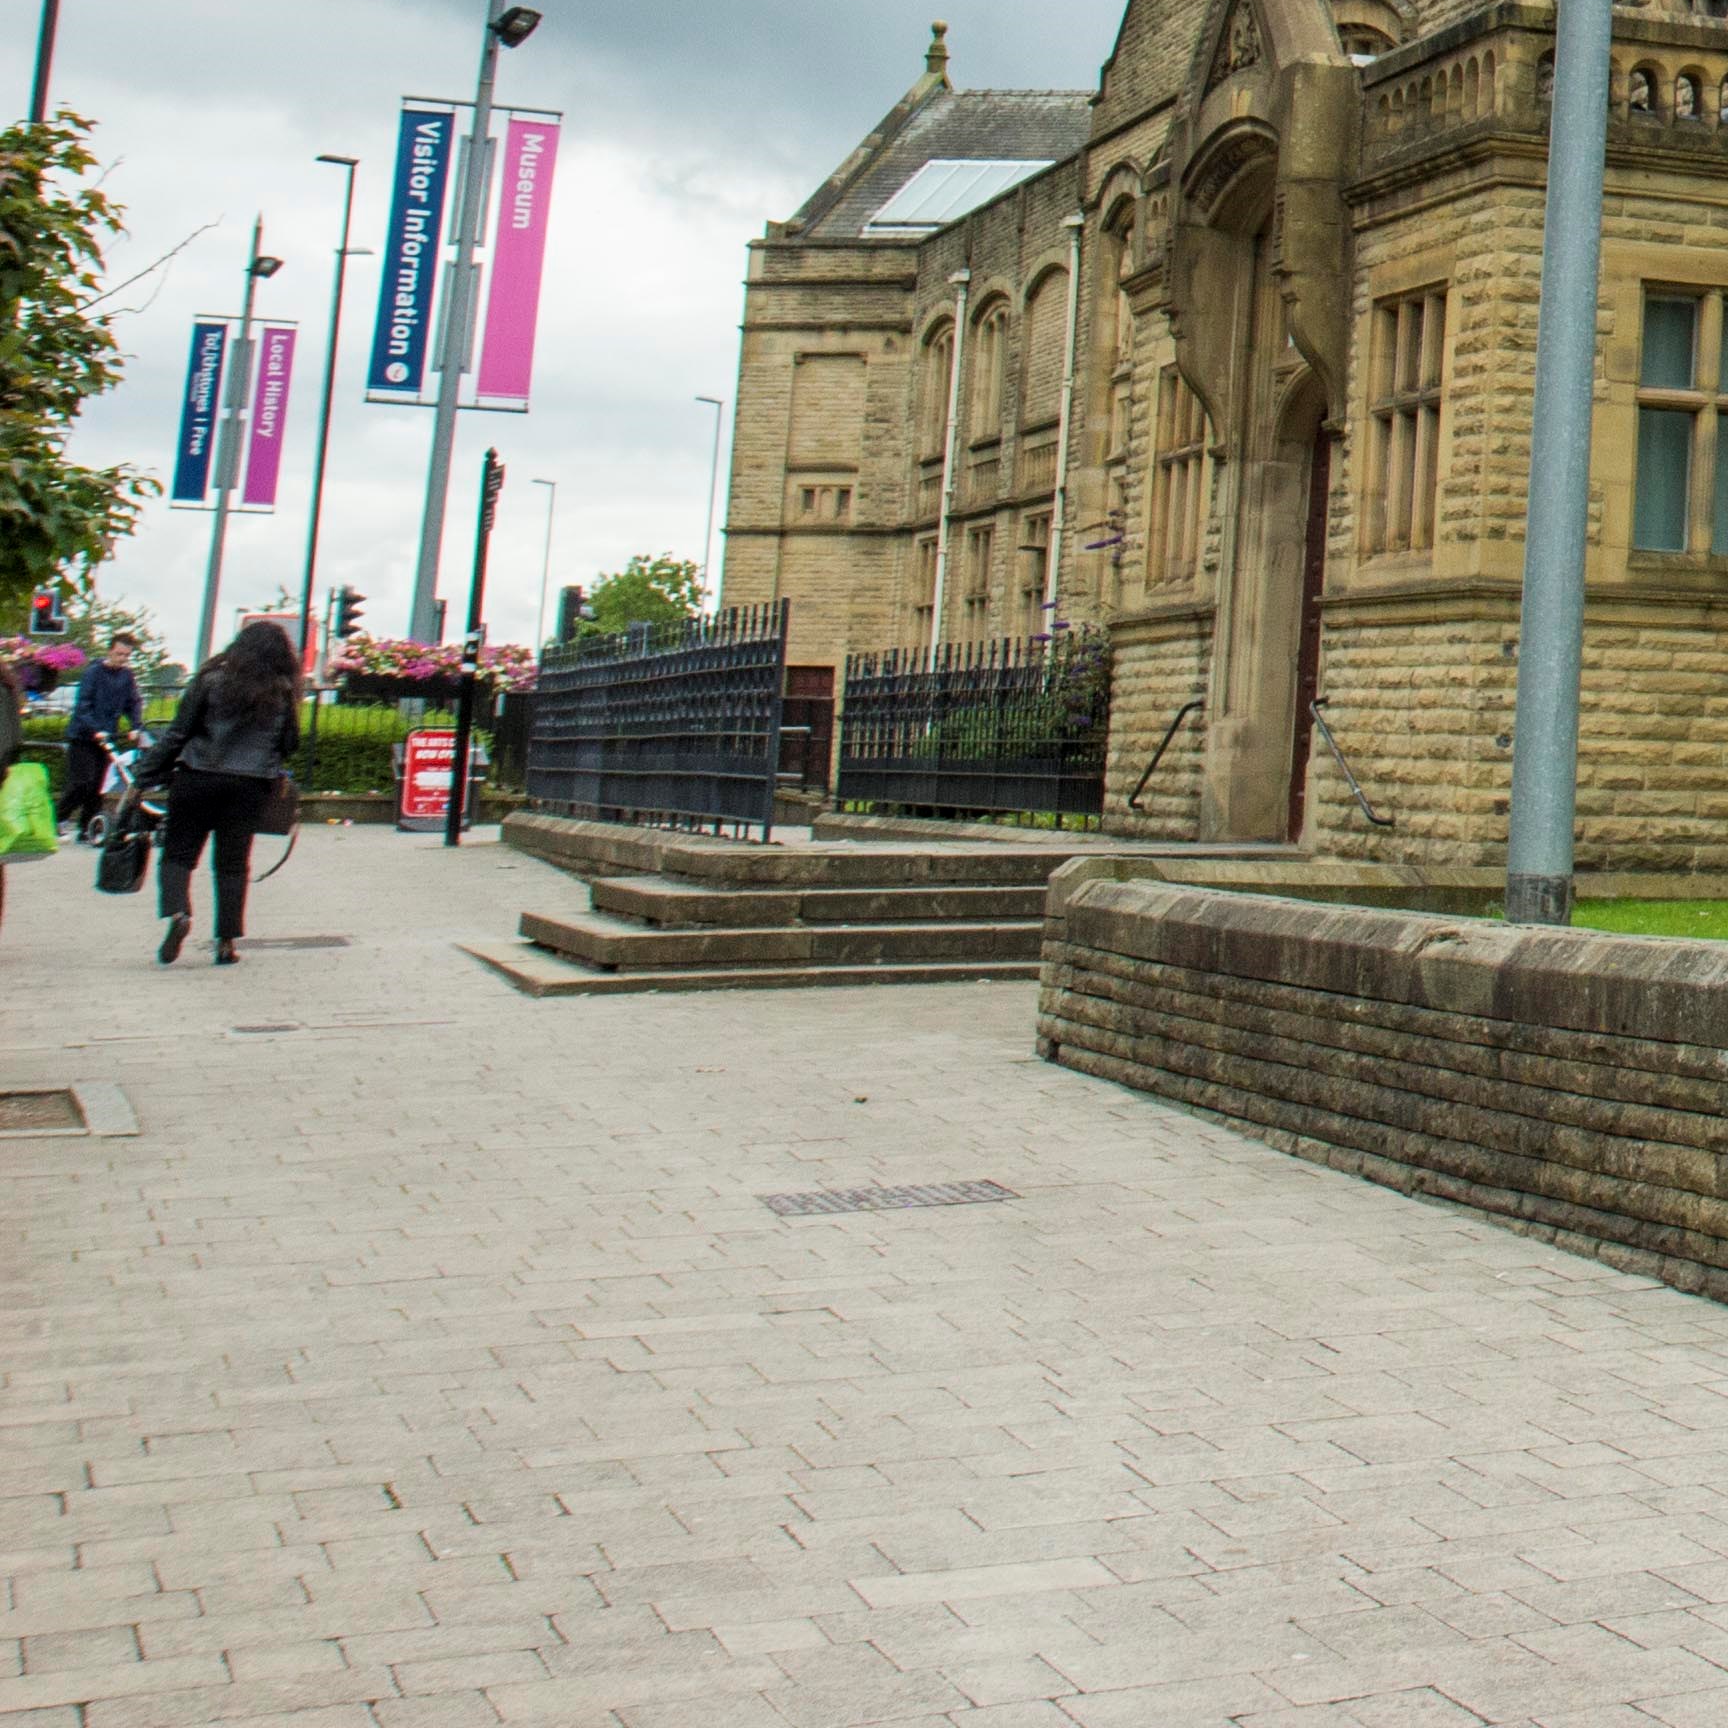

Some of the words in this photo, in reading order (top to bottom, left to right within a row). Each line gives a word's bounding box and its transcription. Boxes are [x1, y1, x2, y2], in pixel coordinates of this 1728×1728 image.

[408, 121, 442, 202] Visitor
[512, 133, 545, 229] Museum
[388, 209, 431, 355] Information
[266, 335, 290, 376] Local
[189, 426, 209, 455] Free
[256, 380, 284, 437] History
